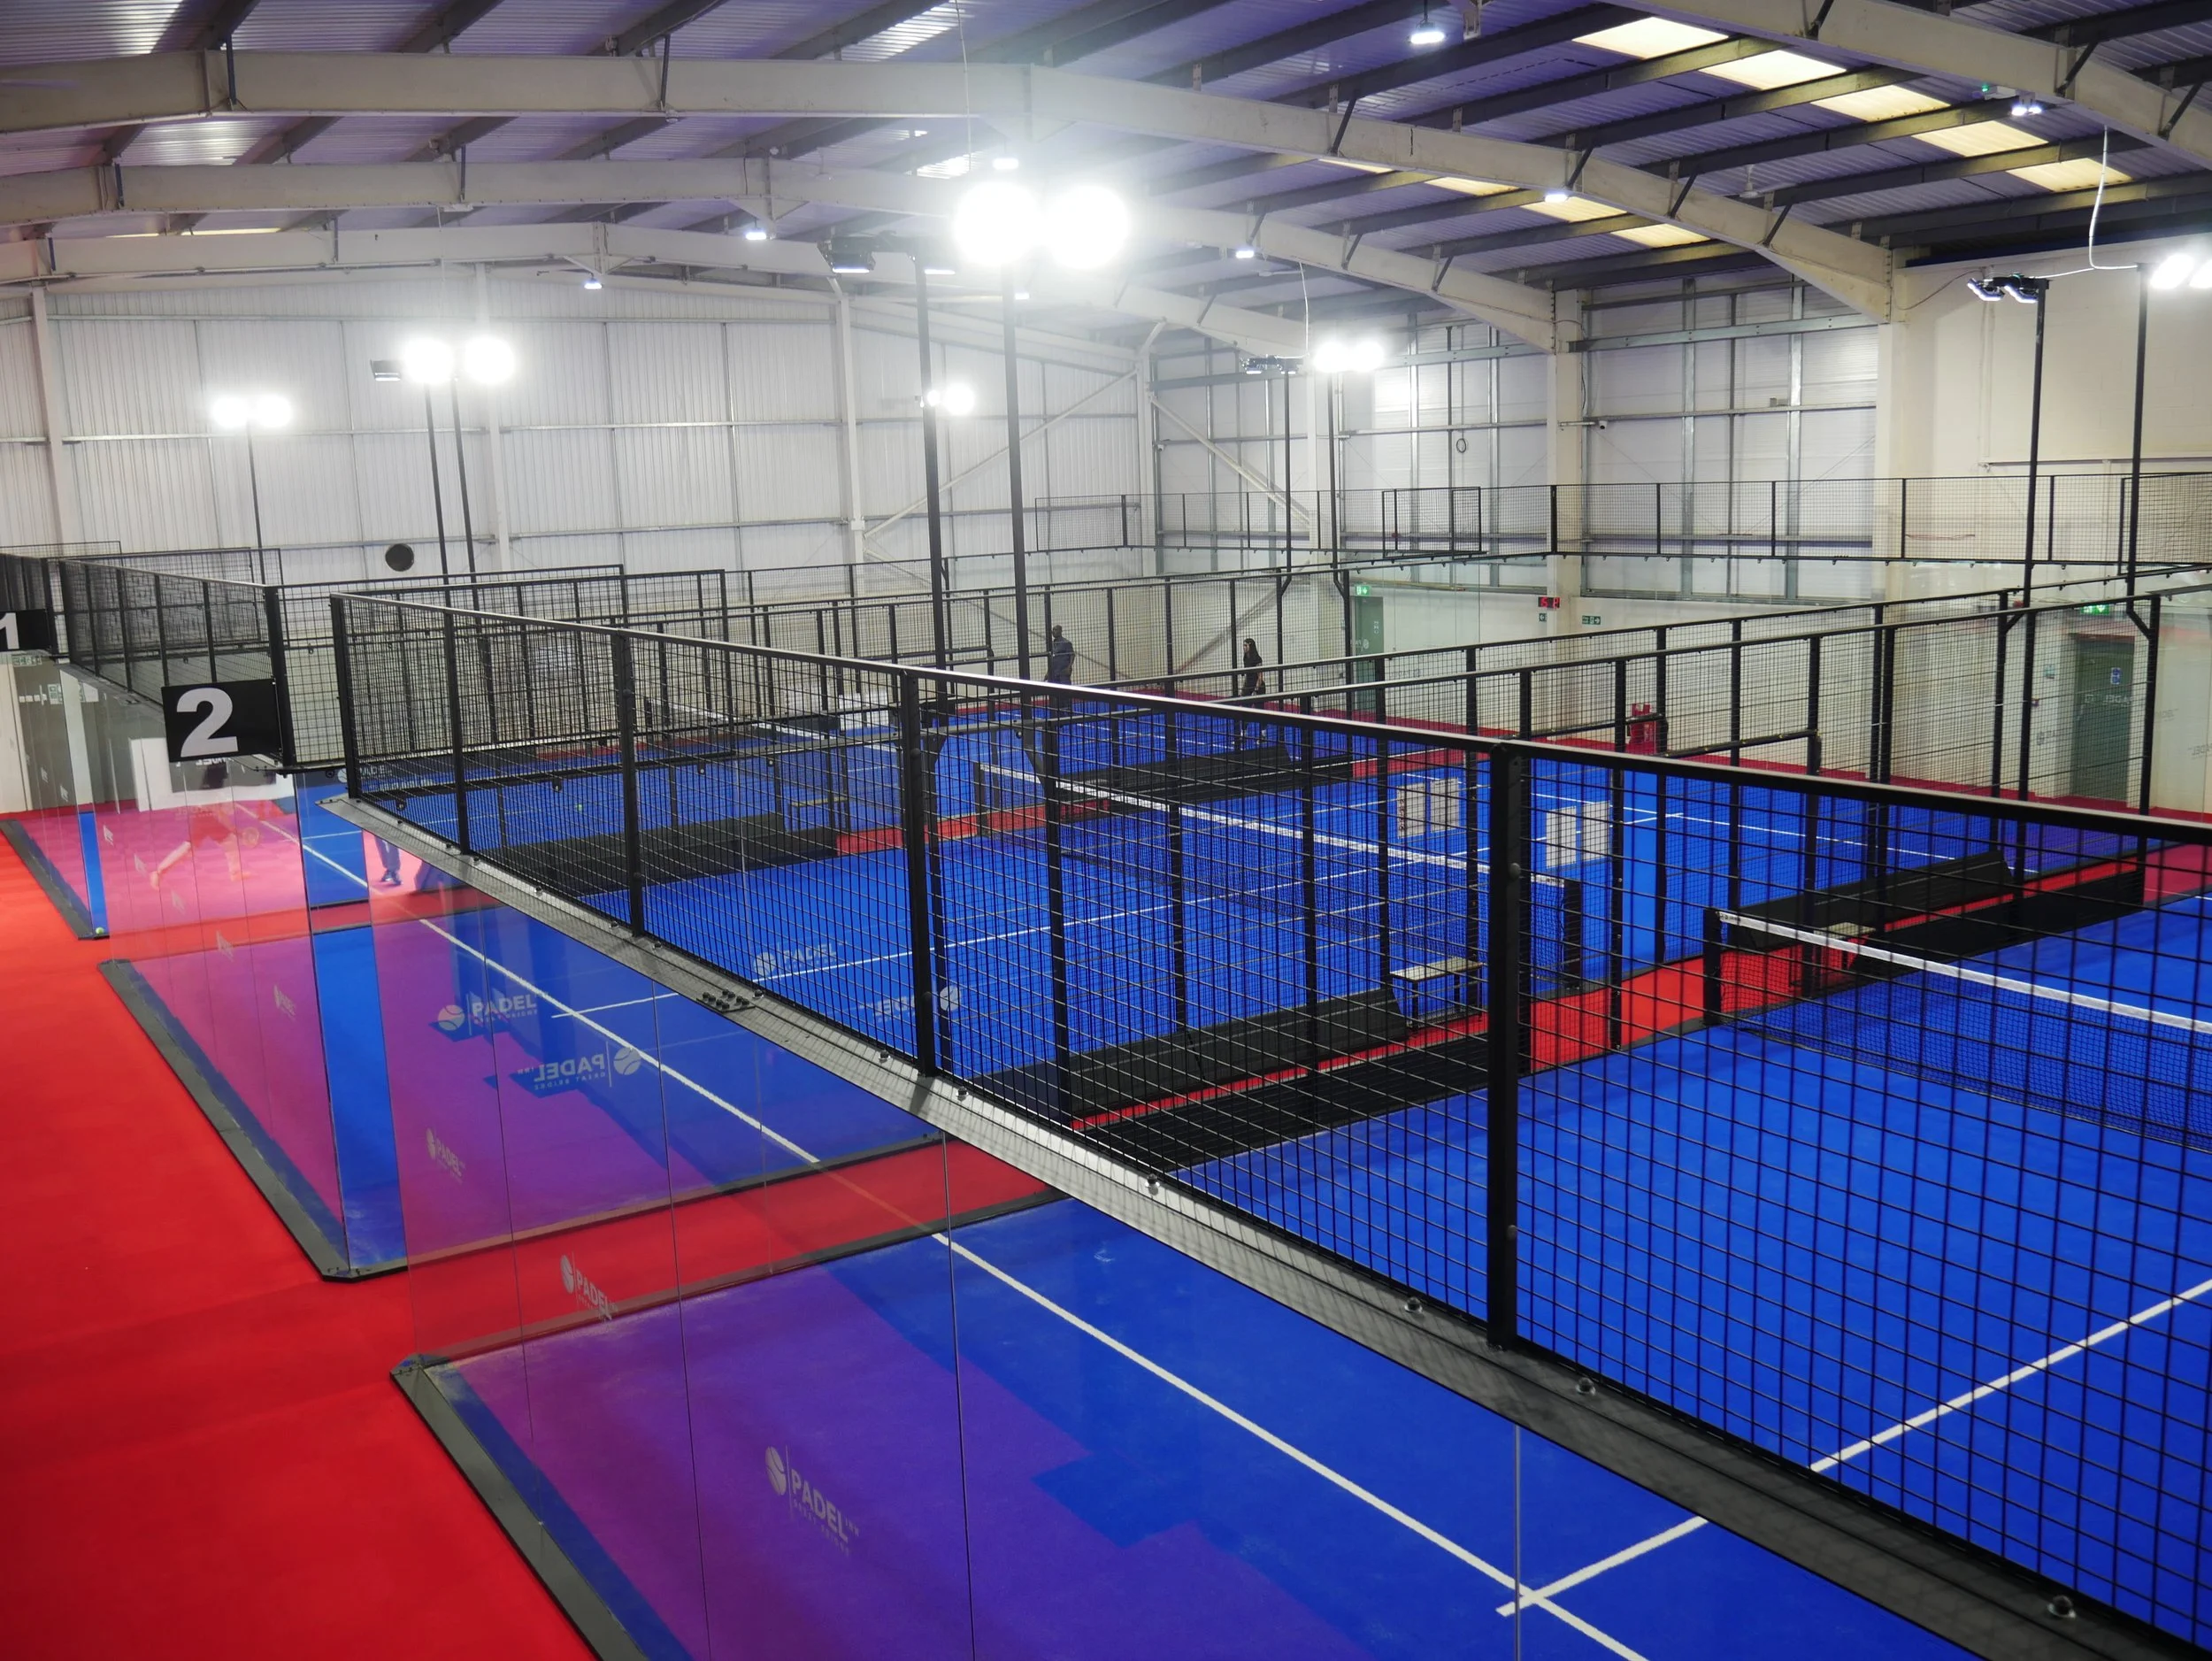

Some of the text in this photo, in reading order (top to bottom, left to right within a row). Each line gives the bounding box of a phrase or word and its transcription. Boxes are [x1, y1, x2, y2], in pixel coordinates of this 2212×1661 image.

[0, 612, 19, 650] 1
[177, 687, 239, 757] 2
[472, 994, 537, 1017] PADEL
[576, 1268, 612, 1321] PADEL
[791, 1468, 849, 1544] PADEL
